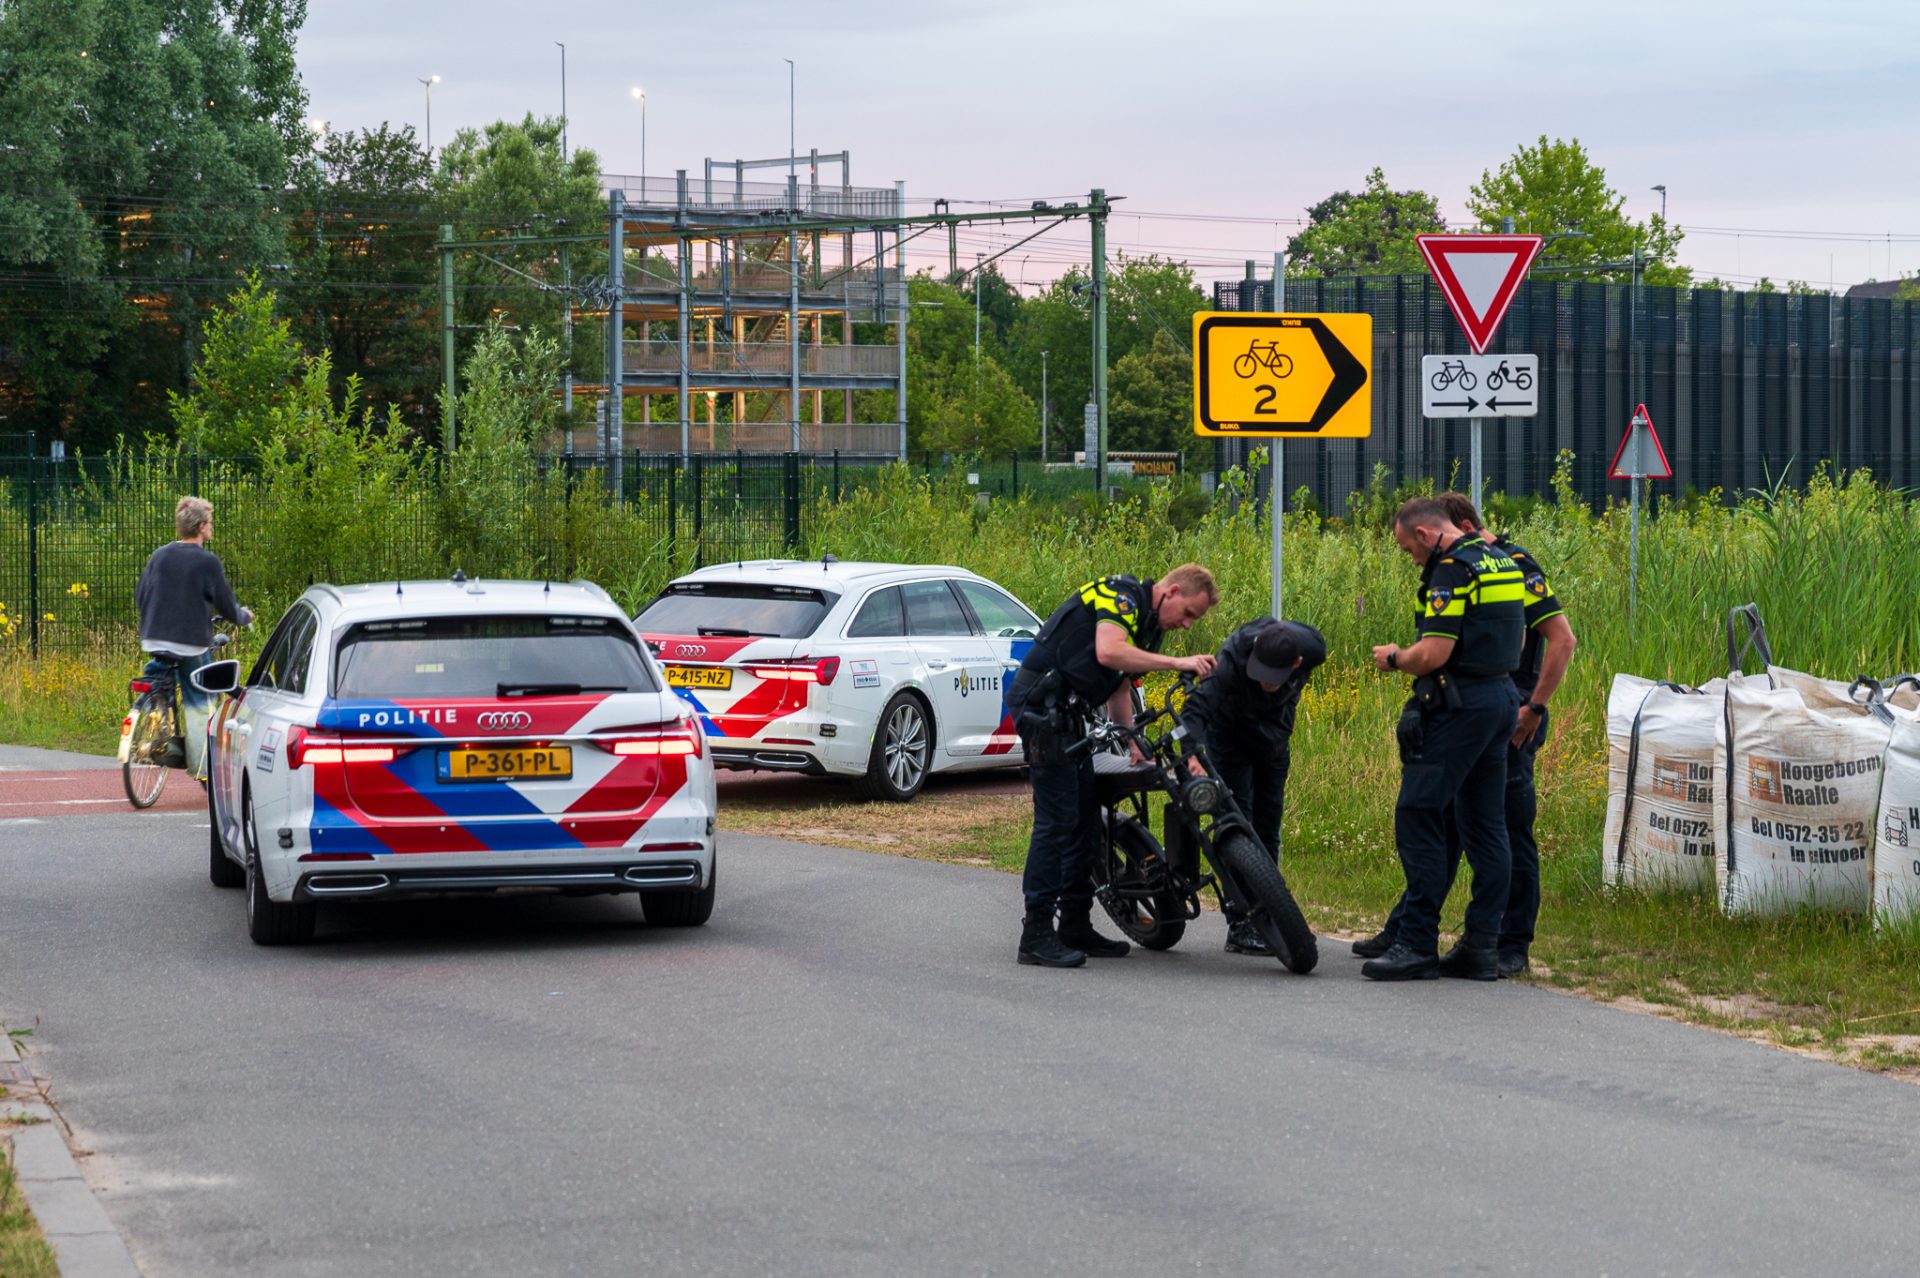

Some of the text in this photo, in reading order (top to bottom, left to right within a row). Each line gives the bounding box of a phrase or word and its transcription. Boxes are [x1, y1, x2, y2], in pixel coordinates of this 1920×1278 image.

[1254, 384, 1277, 414] 2
[667, 669, 726, 685] P-415-NZ
[954, 672, 998, 697] POLITIE
[359, 709, 457, 728] POLITIE
[465, 751, 561, 774] P-361-PL
[1780, 755, 1881, 783] Hoogeboom
[1783, 784, 1840, 807] Raalte
[1649, 811, 1670, 832] Bel
[1751, 816, 1773, 838] Bel
[1775, 822, 1841, 844] 0572-35
